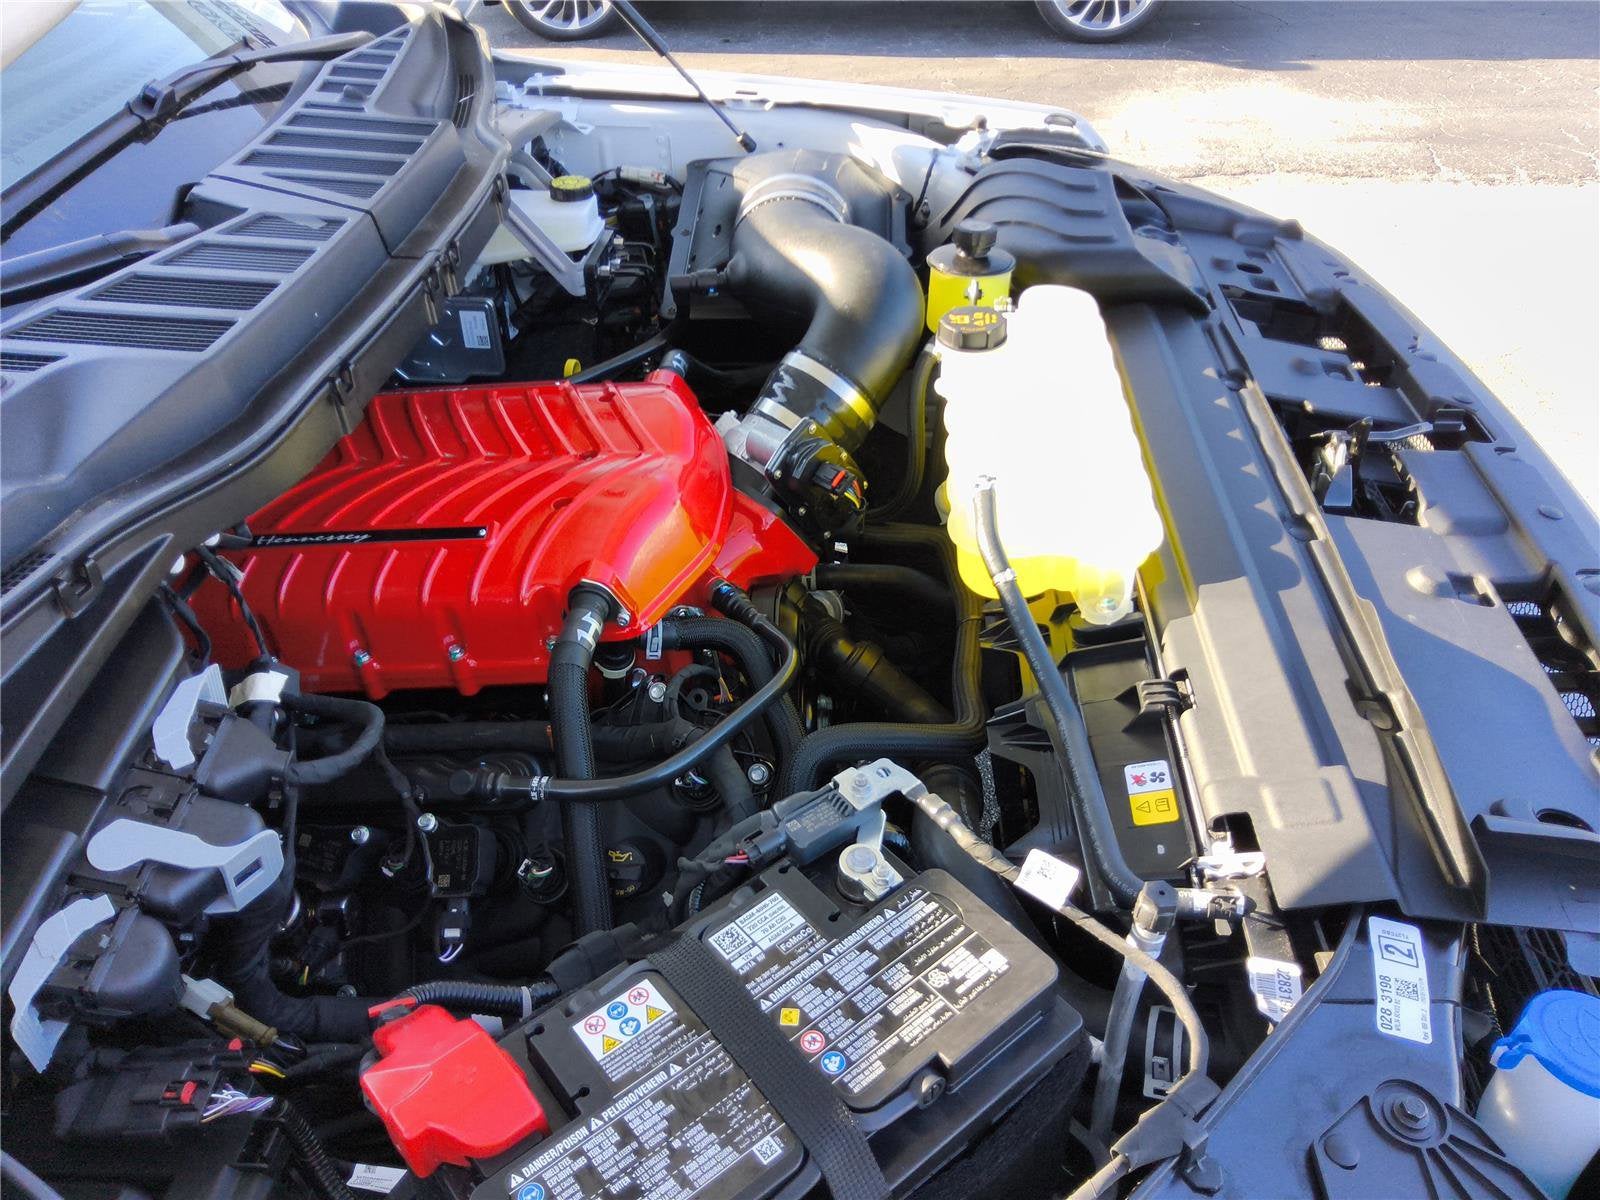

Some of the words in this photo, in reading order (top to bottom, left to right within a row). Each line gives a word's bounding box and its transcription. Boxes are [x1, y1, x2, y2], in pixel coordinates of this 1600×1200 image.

[256, 530, 371, 547] Hennessey
[780, 925, 812, 951] FoMoCo
[832, 914, 884, 956] PELIGRO/VENENO
[1384, 943, 1414, 961] 2
[770, 959, 823, 1002] DANGER/POISON
[1379, 974, 1394, 1004] 3198
[1379, 1007, 1392, 1031] 028
[838, 1038, 850, 1049] READ
[848, 1032, 857, 1040] ALL
[601, 1070, 668, 1121] PELIGRO/VENENO
[642, 1099, 653, 1109] LOS
[641, 1110, 652, 1120] LOS
[649, 1100, 665, 1114] GASES
[609, 1132, 620, 1143] GAZ
[672, 1139, 682, 1149] NO
[684, 1123, 704, 1140] CHISPAS
[521, 1126, 590, 1177] DANGER/POISON
[546, 1167, 573, 1187] EXPLOSIVE
[570, 1156, 587, 1171] GASES
[609, 1174, 631, 1194] ÉVITER
[634, 1166, 645, 1176] LES
[642, 1147, 669, 1169] ÉTINCELLES
[639, 1173, 649, 1182] LES
[648, 1157, 671, 1176] FLAMMES
[644, 1180, 653, 1189] DE
[650, 1169, 668, 1184] FUMER
[552, 1185, 562, 1195] CAN
[560, 1176, 575, 1189] CAUSE
